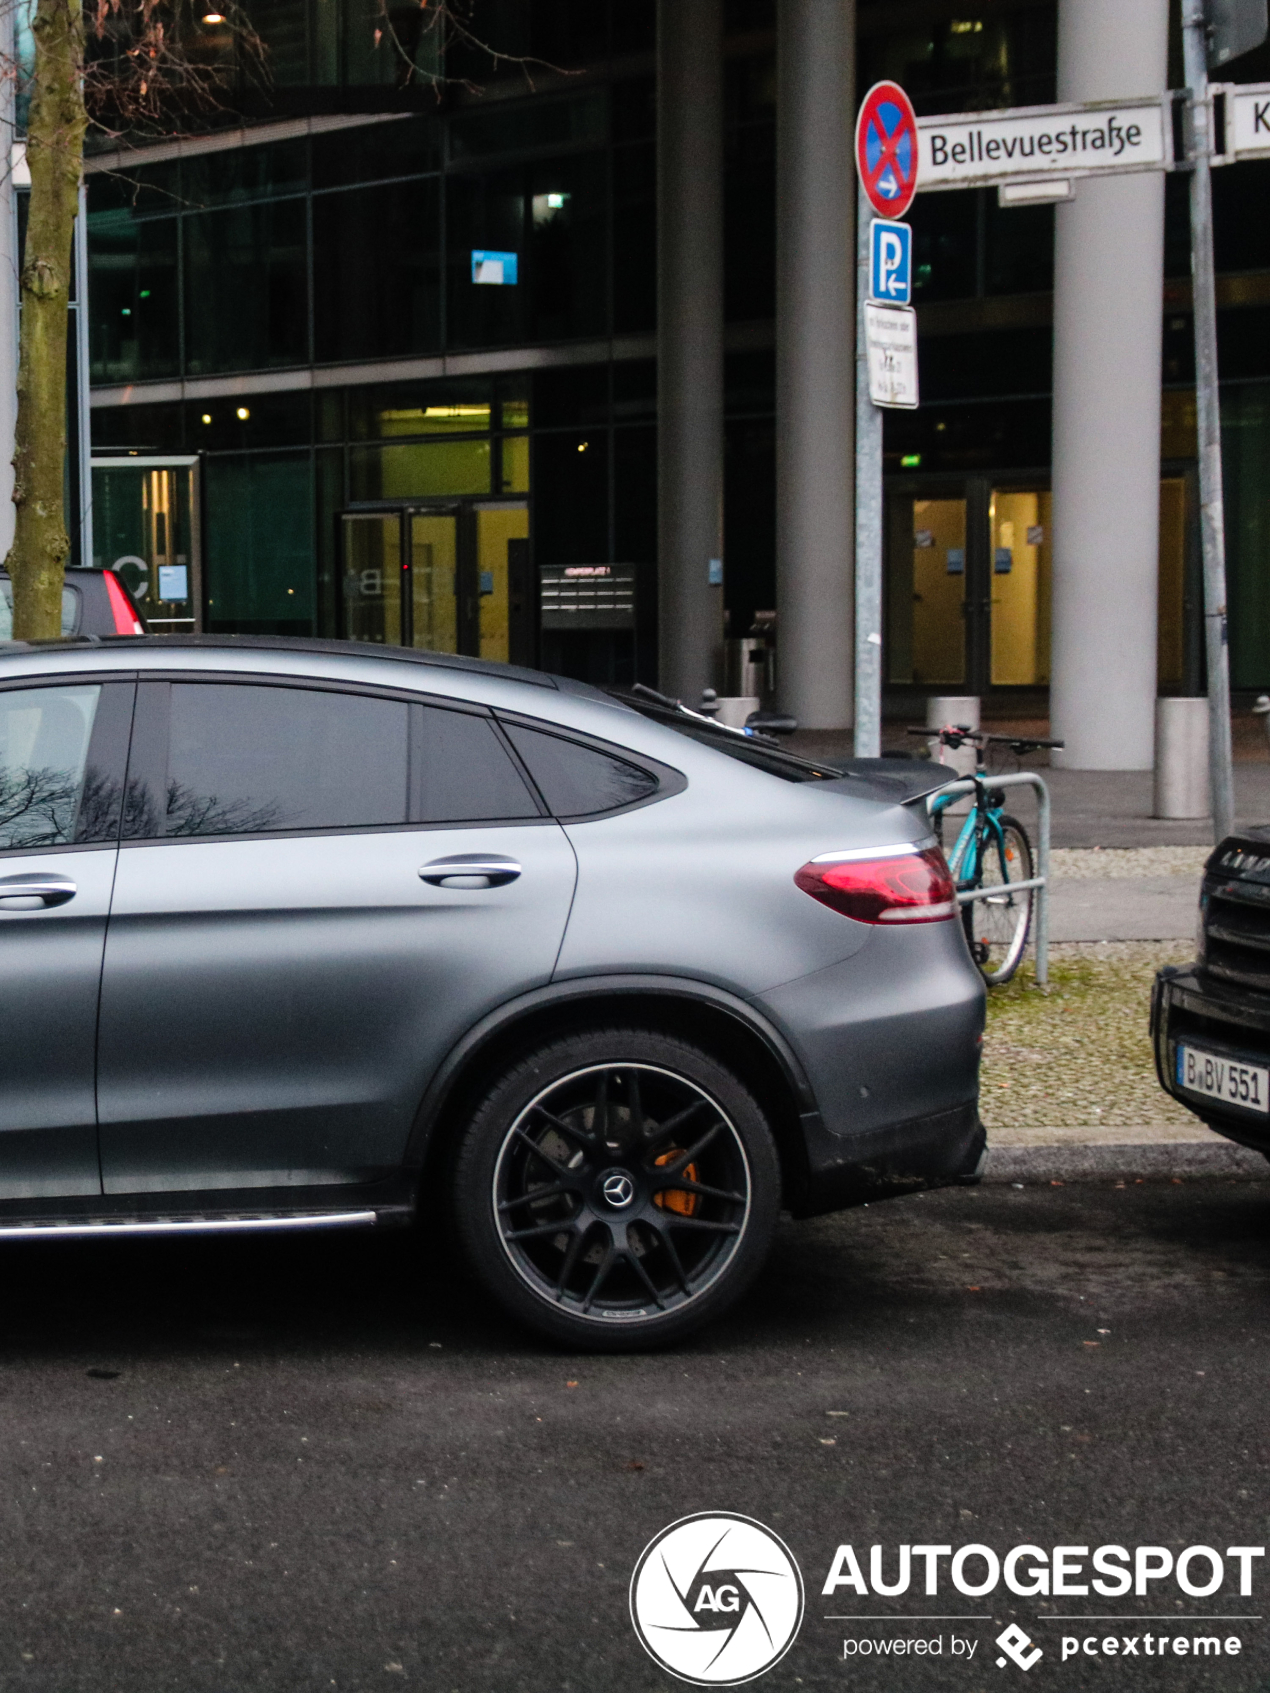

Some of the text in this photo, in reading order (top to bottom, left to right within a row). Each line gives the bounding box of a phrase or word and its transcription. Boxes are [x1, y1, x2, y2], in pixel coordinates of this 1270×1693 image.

[930, 116, 1142, 166] Bellevuestraße
[879, 230, 902, 292] P
[1187, 1053, 1262, 1105] B BV 551
